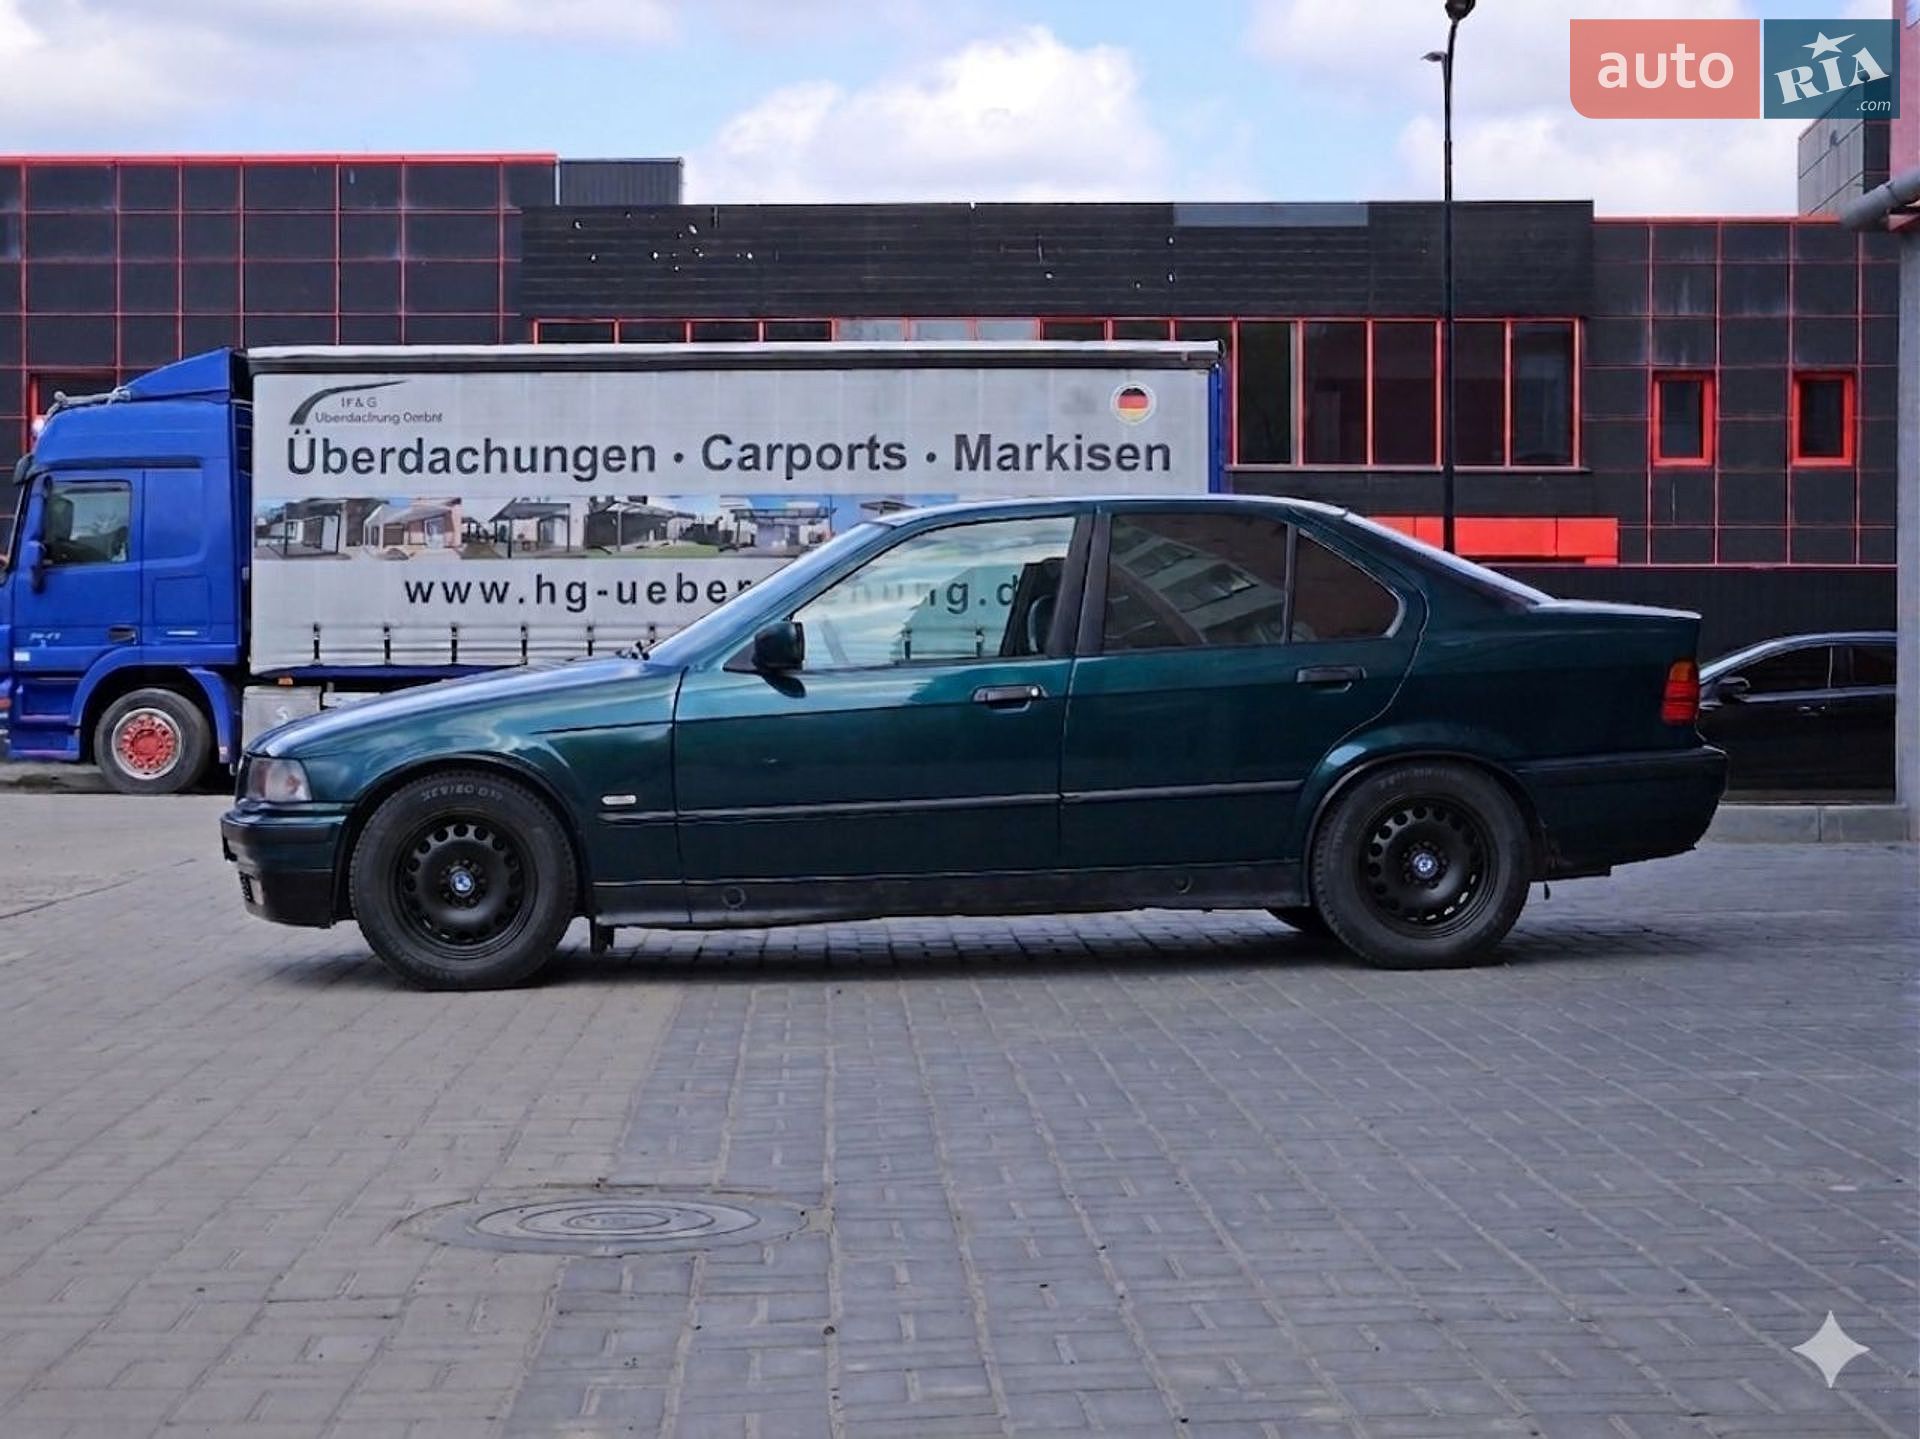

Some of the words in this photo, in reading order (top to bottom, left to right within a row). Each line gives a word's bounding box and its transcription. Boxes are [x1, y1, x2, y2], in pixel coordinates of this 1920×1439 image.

[287, 428, 656, 483] Überdachungen
[701, 433, 907, 481] Carports
[954, 433, 1172, 472] Markisen
